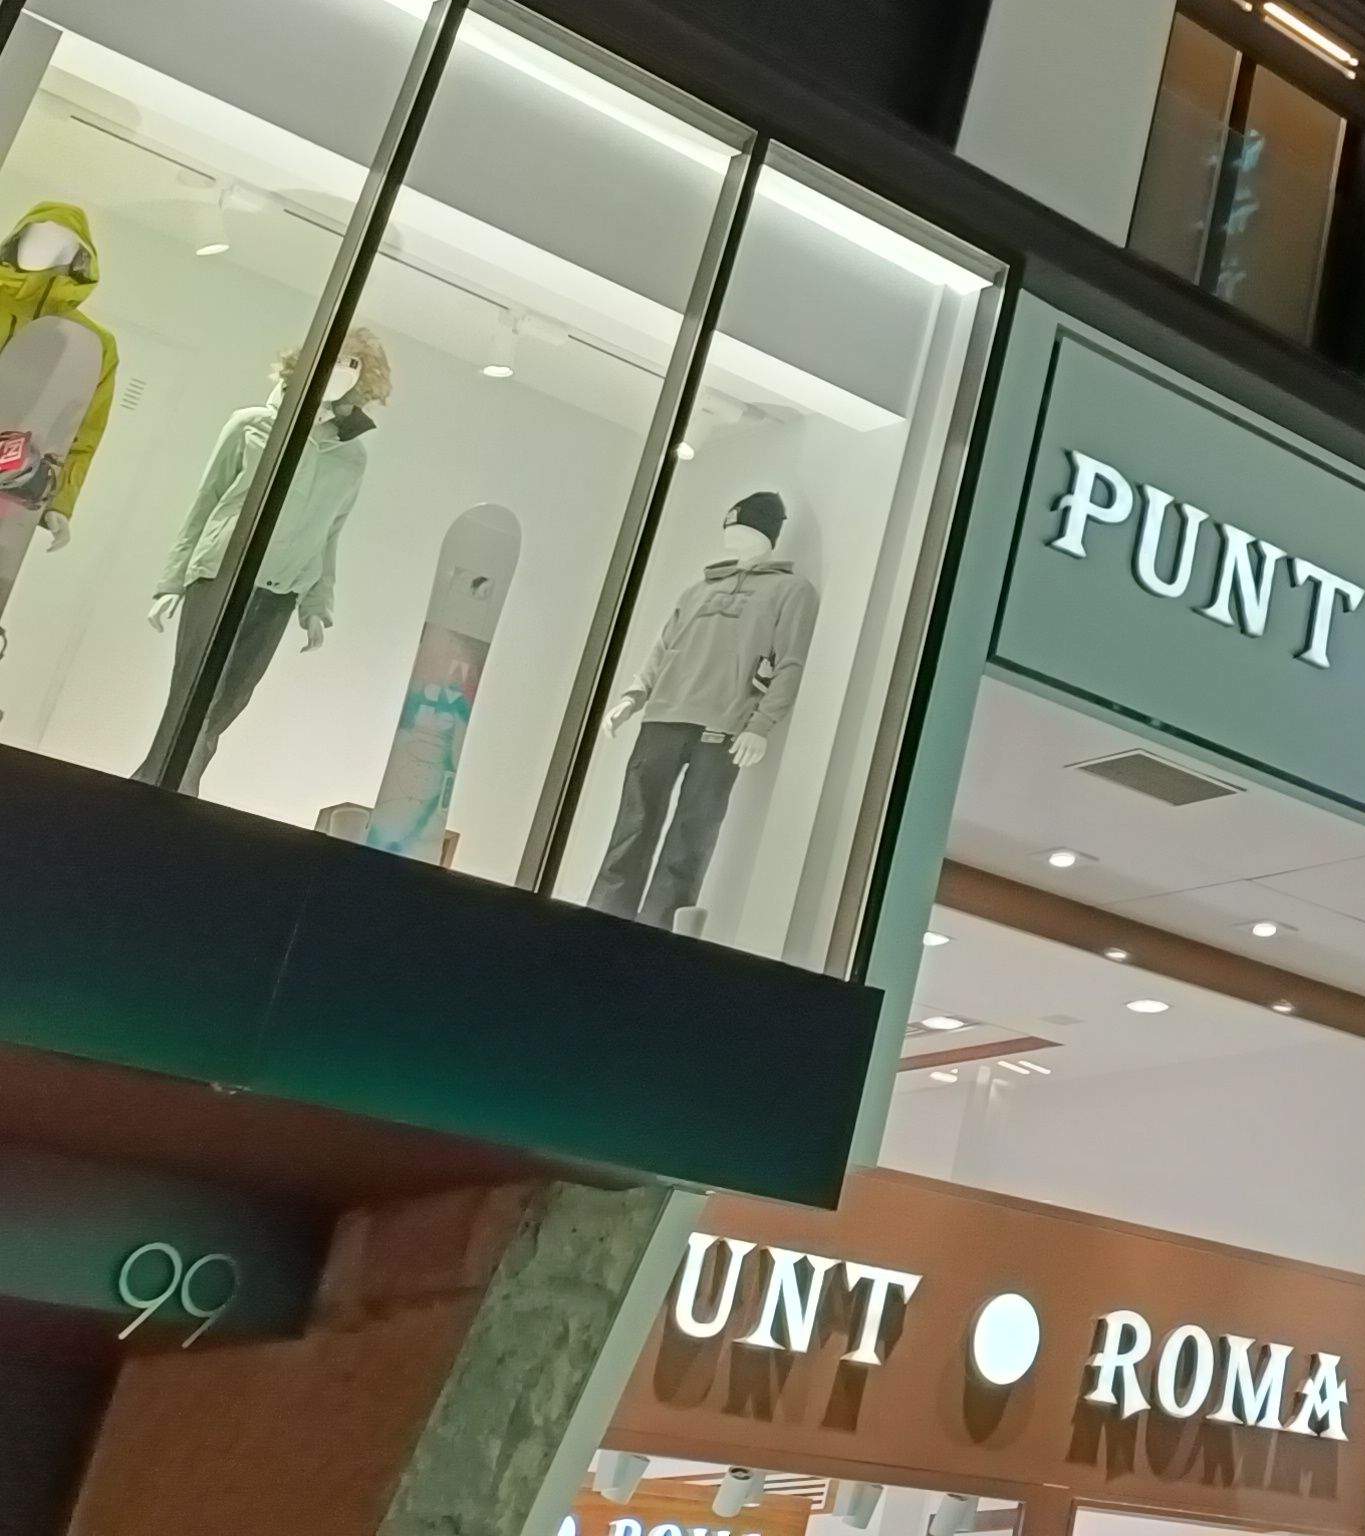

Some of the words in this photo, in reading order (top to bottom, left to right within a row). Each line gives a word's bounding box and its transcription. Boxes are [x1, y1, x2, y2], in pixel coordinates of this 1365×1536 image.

[1047, 449, 1365, 669] PUNT
[117, 1240, 241, 1350] 99
[672, 1230, 924, 1367] UNT
[1085, 1309, 1351, 1442] ROMA
